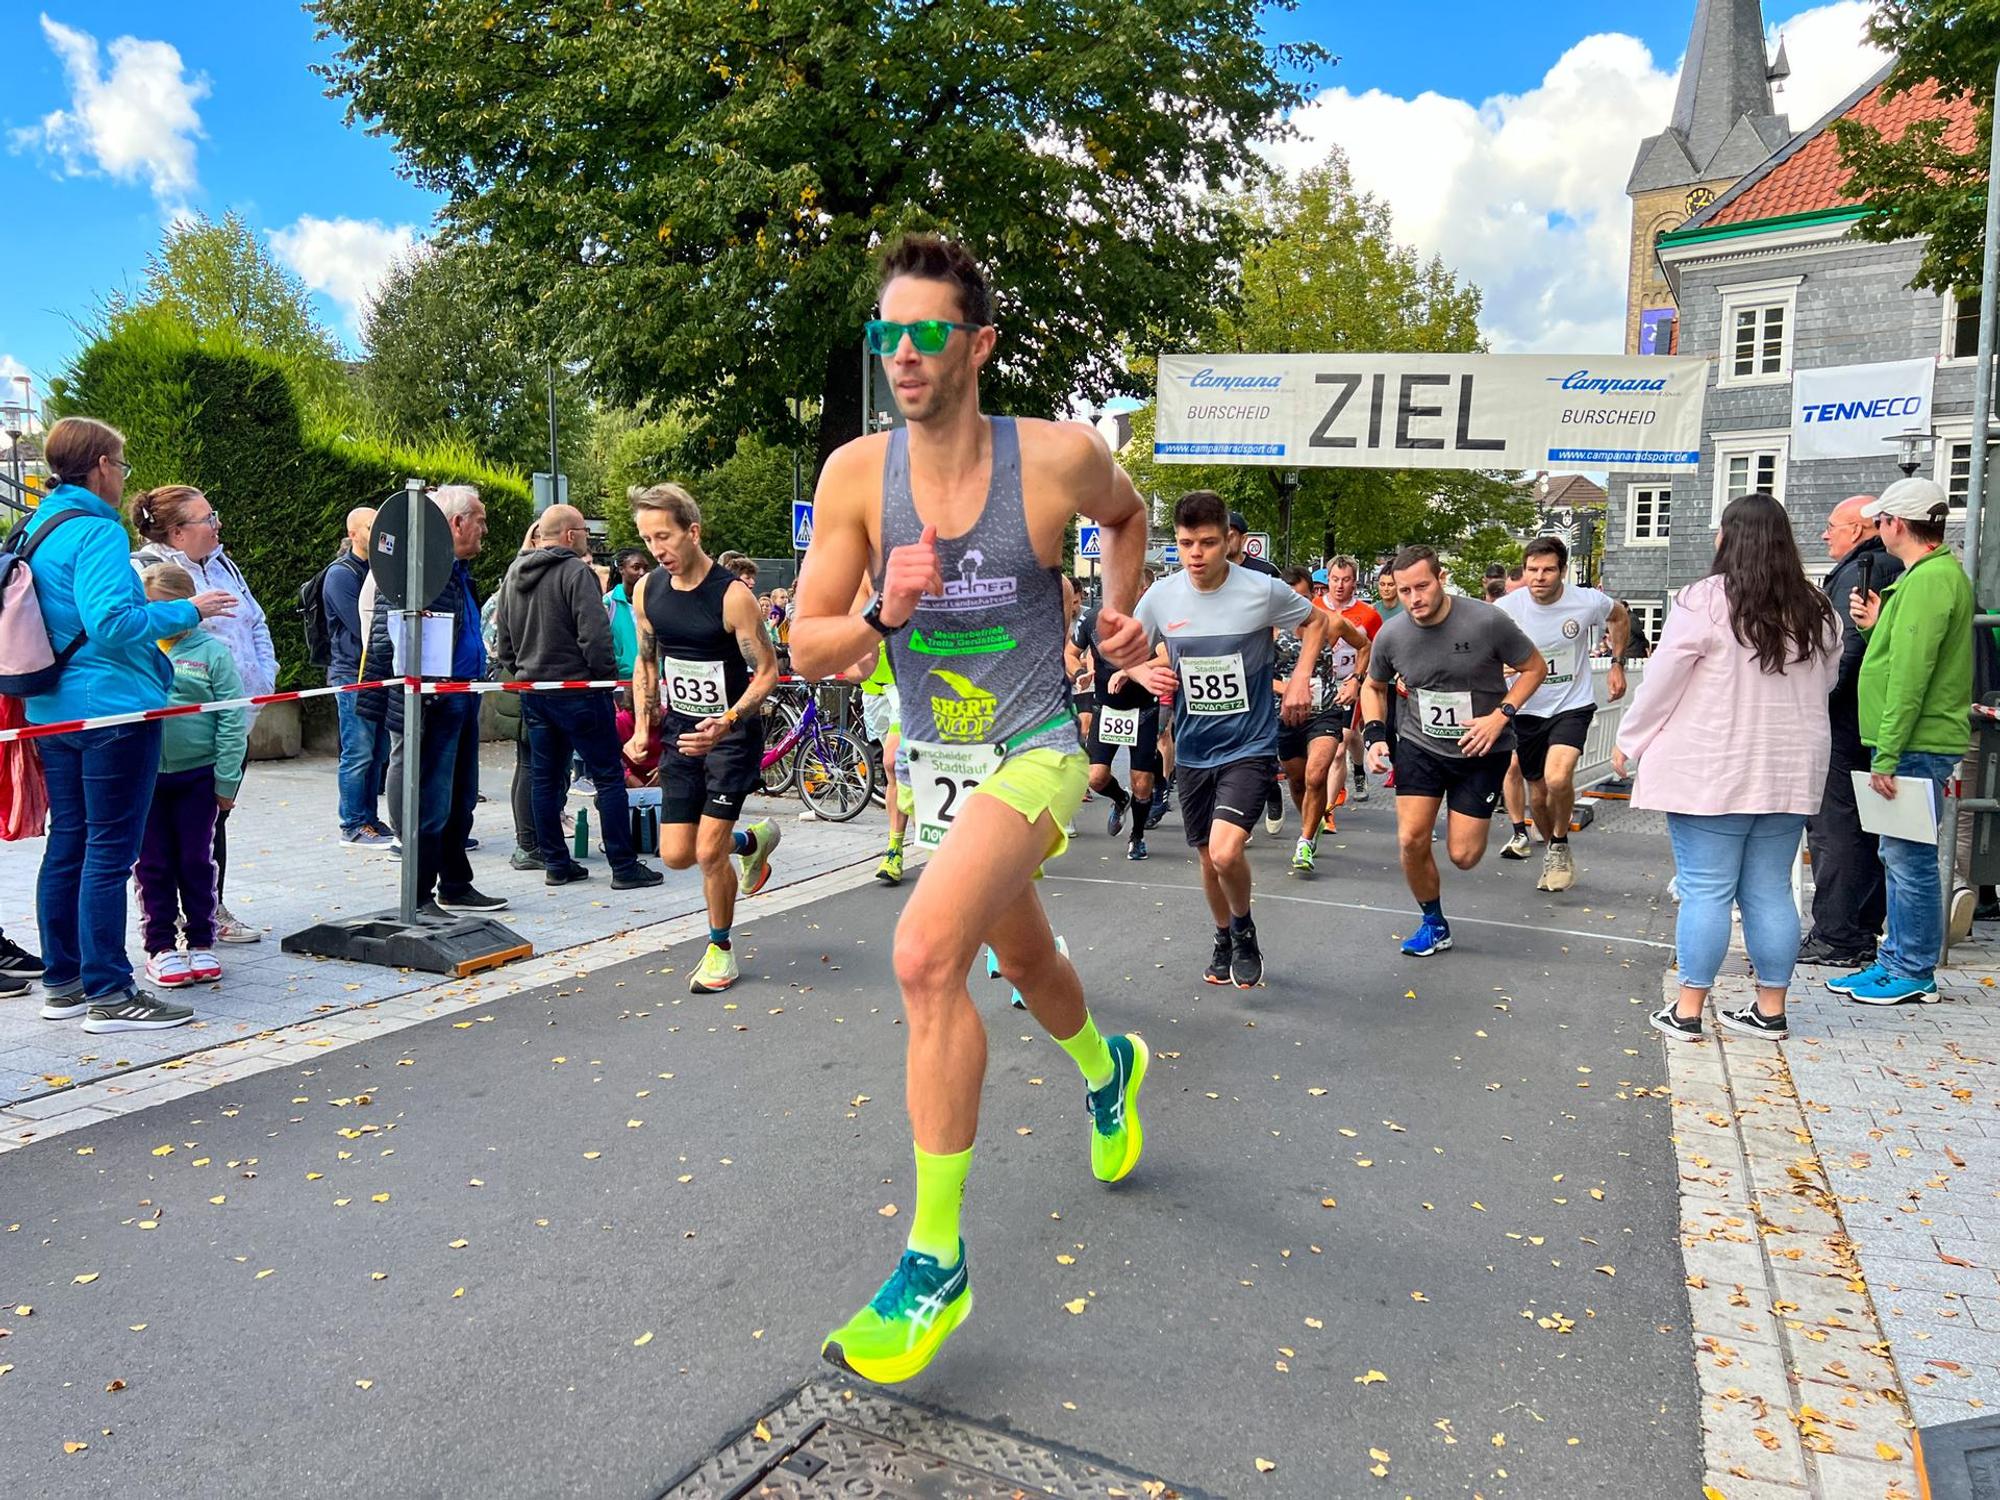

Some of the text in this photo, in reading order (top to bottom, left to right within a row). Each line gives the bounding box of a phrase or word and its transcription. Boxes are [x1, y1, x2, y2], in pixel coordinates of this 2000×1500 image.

[1177, 368, 1282, 391] Campana
[1546, 370, 1667, 394] Campana
[1187, 405, 1271, 420] BURSCHEID
[1309, 373, 1506, 450] ZIEL
[1561, 409, 1656, 425] BURSCHEID
[1802, 396, 1921, 423] TENNECO
[1250, 543, 1260, 553] 20
[673, 676, 719, 704] 633
[1189, 673, 1239, 700] 585
[1103, 717, 1134, 735] 589
[1431, 706, 1459, 727] 21
[918, 749, 974, 761] urscheider
[931, 759, 988, 775] Stadtlauf
